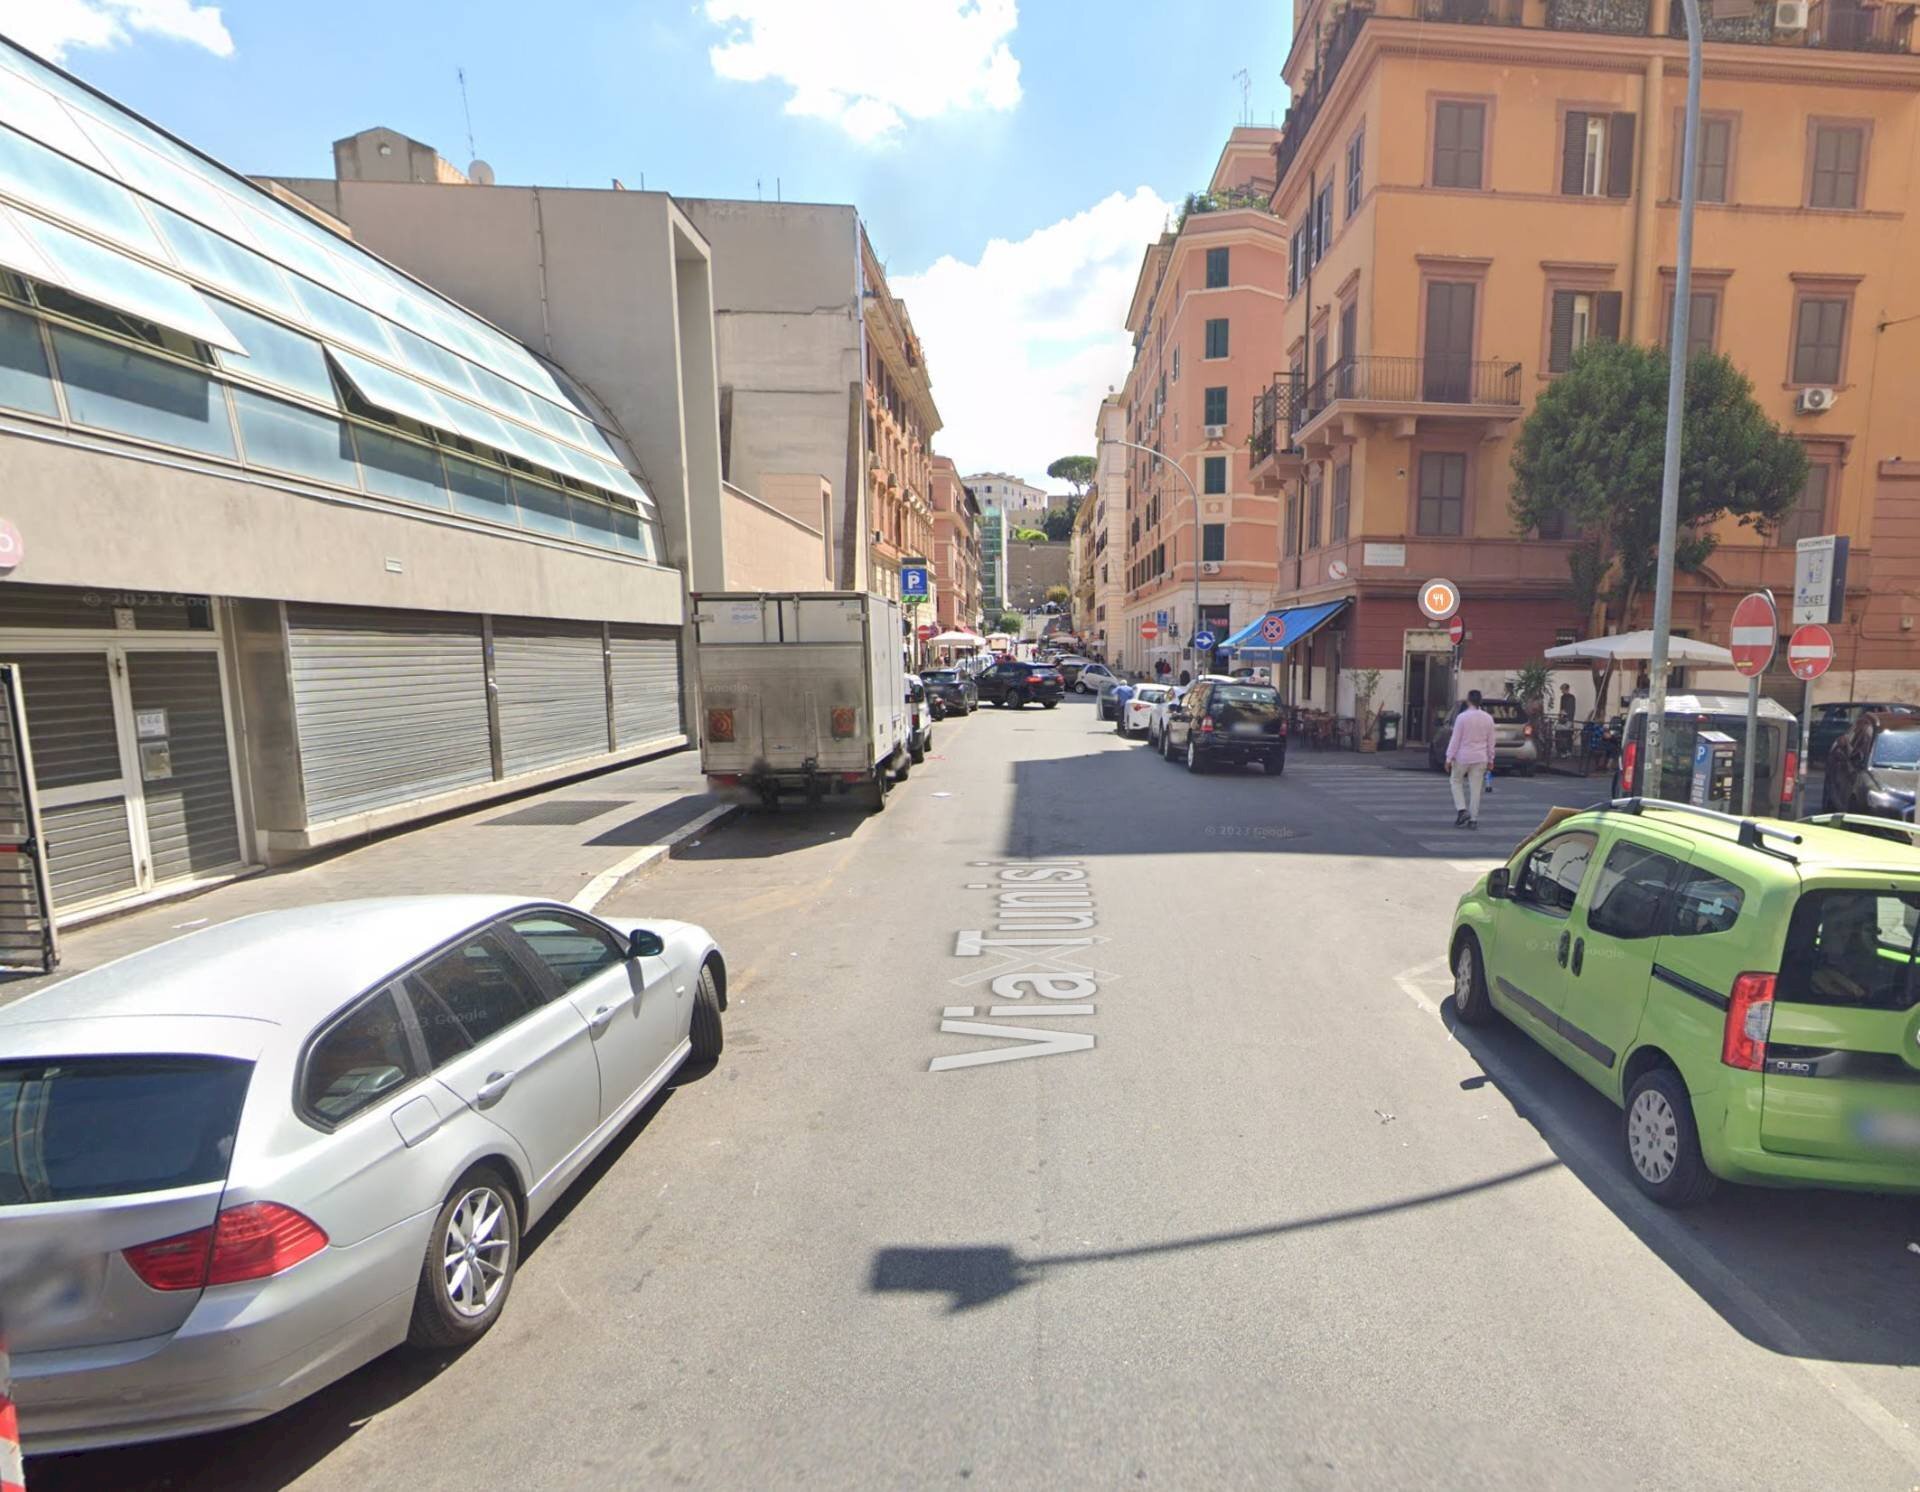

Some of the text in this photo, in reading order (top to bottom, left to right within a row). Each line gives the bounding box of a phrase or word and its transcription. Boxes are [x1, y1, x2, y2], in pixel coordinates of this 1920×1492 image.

[907, 574, 920, 589] P
[1797, 594, 1825, 605] TICKET
[1696, 745, 1706, 760] P
[1776, 1060, 1810, 1072] QUBO
